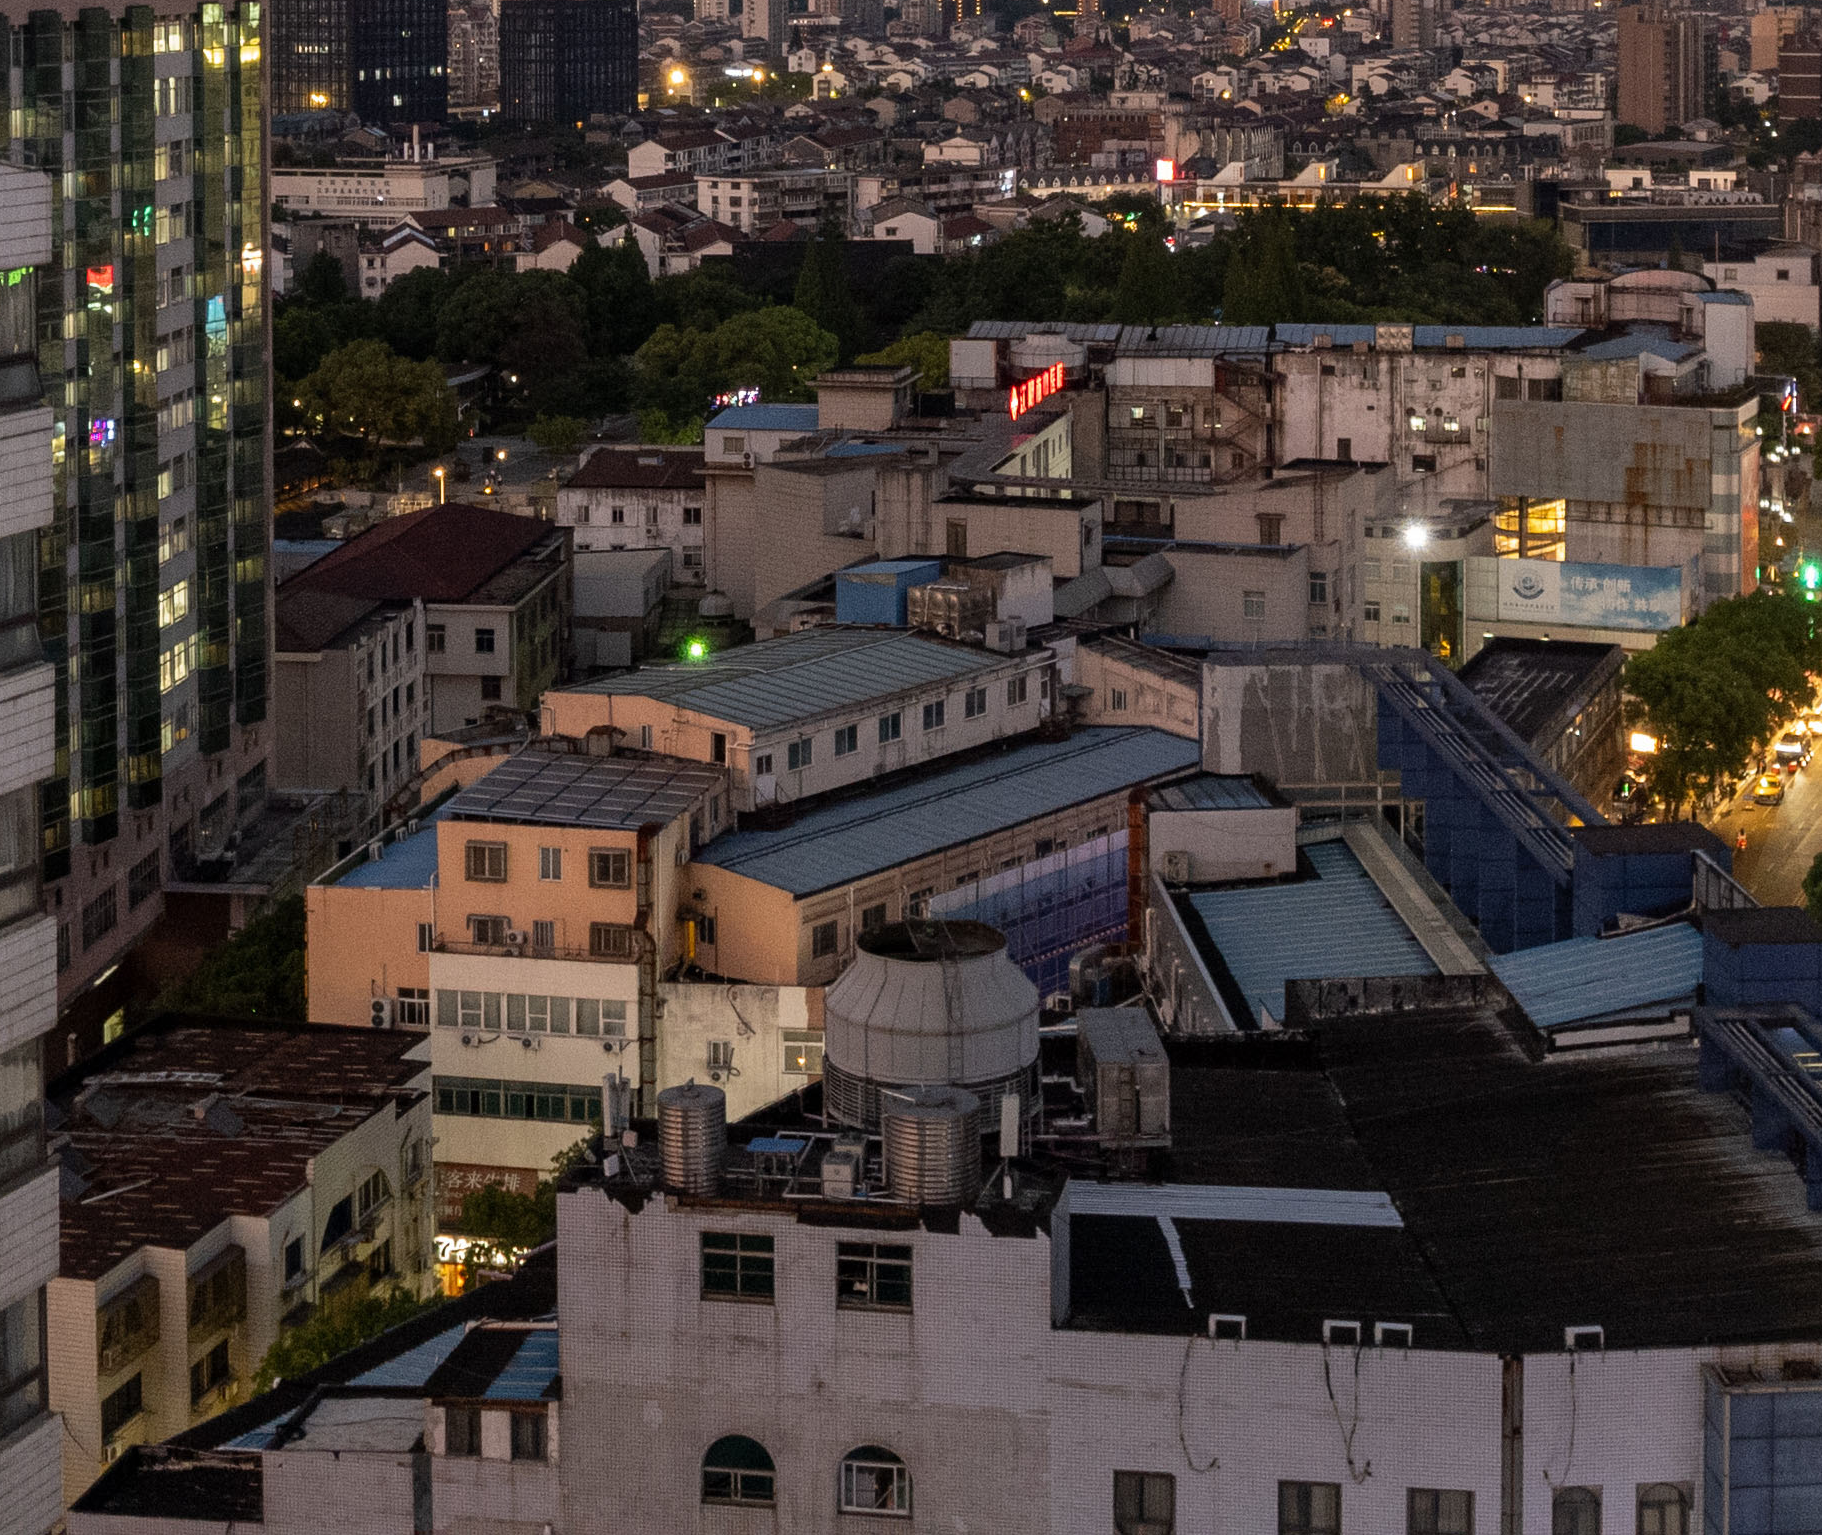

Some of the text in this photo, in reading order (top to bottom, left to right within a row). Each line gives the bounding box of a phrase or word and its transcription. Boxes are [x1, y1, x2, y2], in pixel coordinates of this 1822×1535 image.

[1571, 576, 1631, 593] 传承 创新
[439, 1169, 521, 1192] 客来牛排
